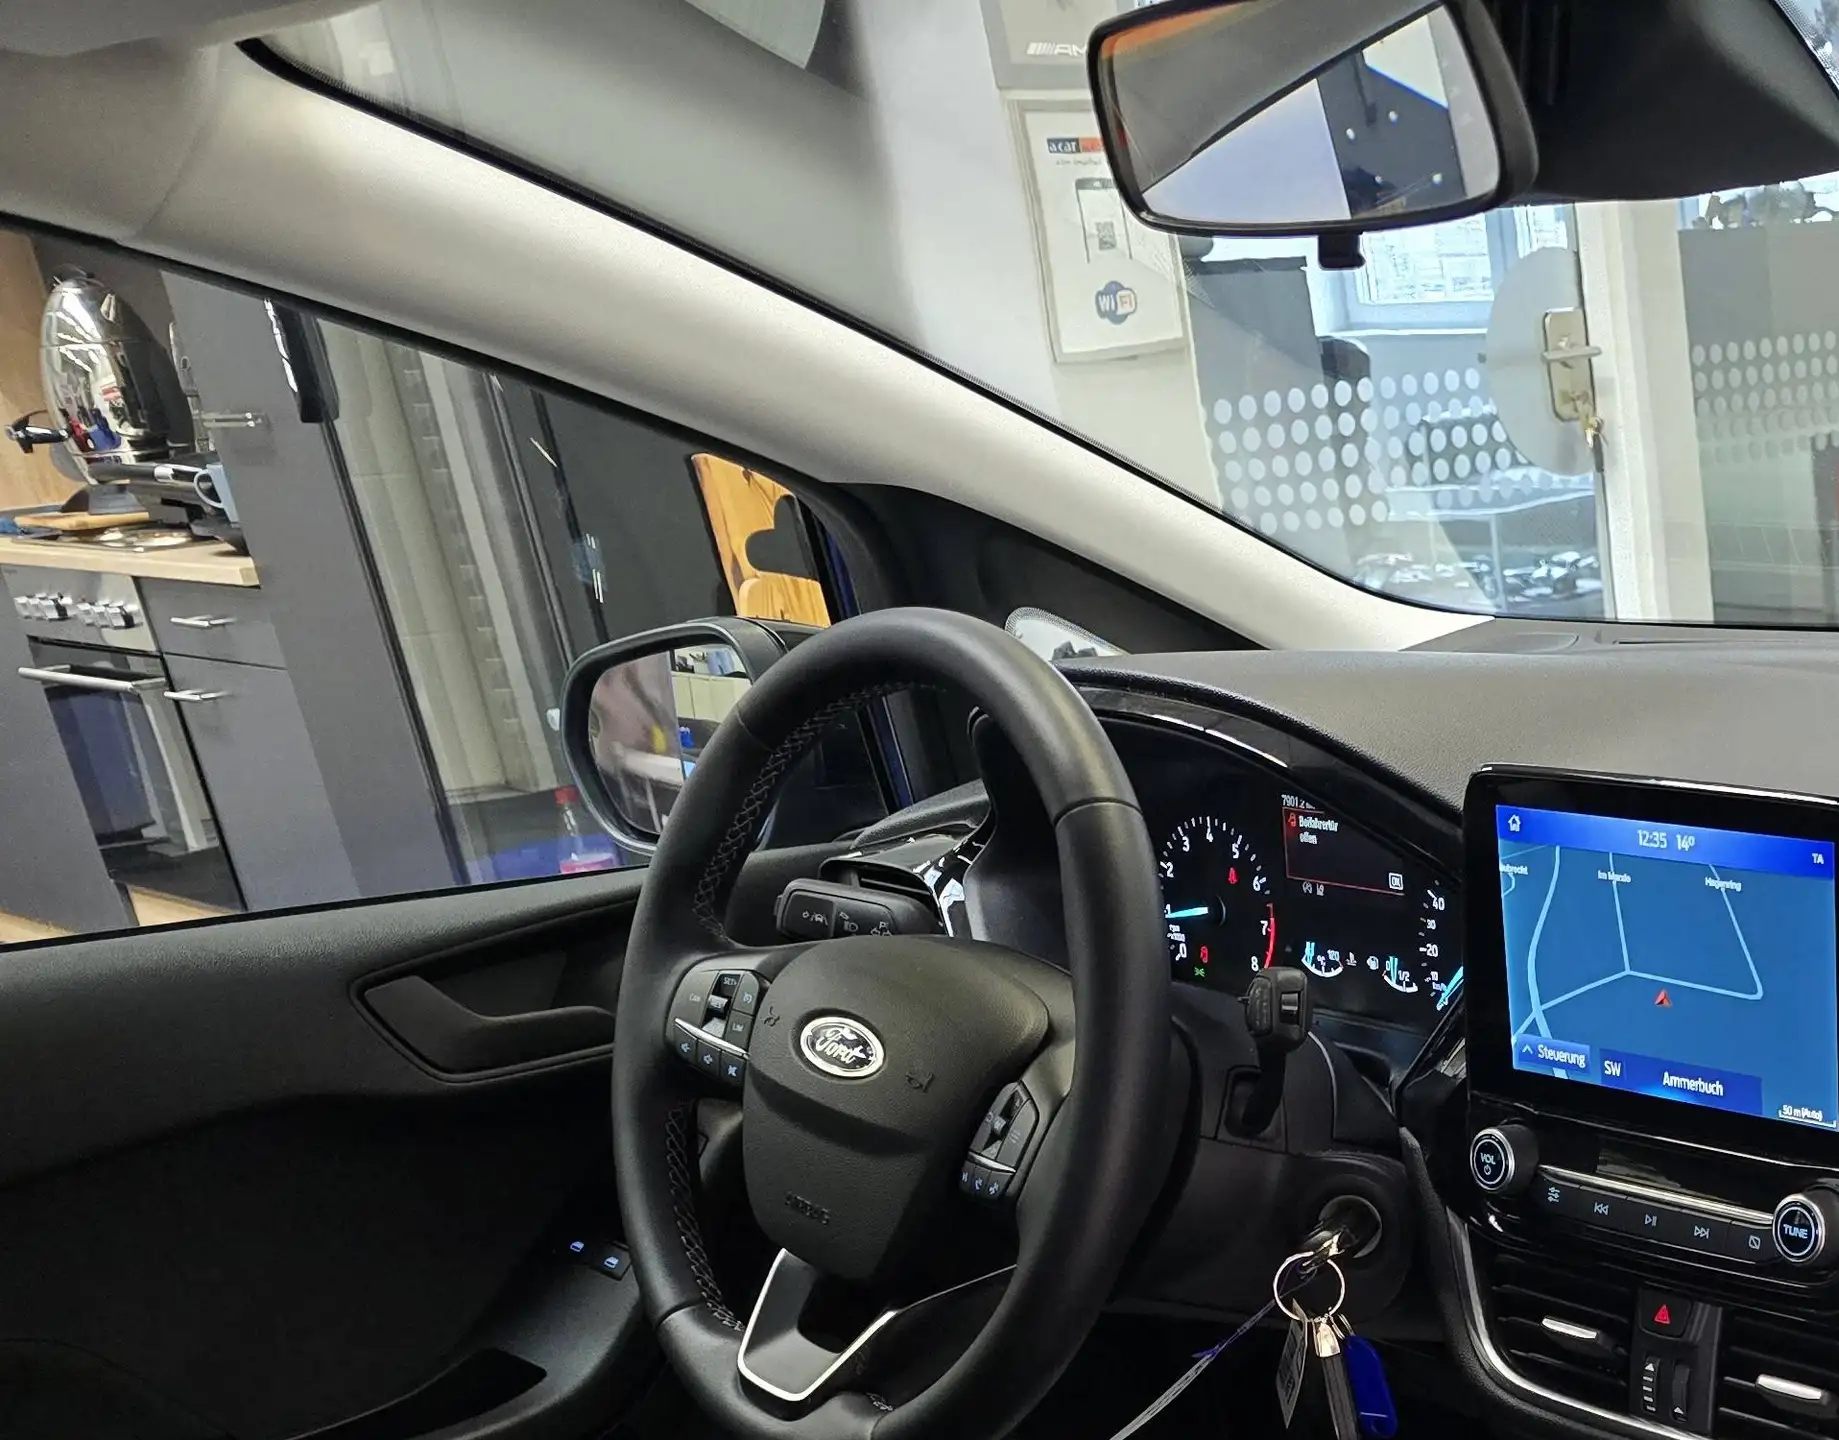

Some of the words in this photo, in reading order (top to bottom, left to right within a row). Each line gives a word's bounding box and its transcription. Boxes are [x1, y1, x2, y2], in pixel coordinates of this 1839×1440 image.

[1182, 836, 1190, 852] 3
[1637, 828, 1668, 849] 12:35
[1231, 843, 1240, 859] 5
[1811, 852, 1824, 865] TA
[1166, 861, 1175, 878] 2
[1252, 875, 1261, 891] 6
[1432, 897, 1446, 911] 40
[1260, 920, 1269, 935] 7
[1426, 918, 1437, 930] 30
[1327, 949, 1340, 961] 120
[1426, 943, 1439, 957] 20
[1250, 955, 1260, 971] 8
[1537, 1043, 1587, 1069] Steuerung
[1604, 1060, 1622, 1077] SW
[1662, 1070, 1725, 1097] Ammerbuch
[1782, 1104, 1793, 1116] 50
[1480, 1152, 1497, 1165] VOL
[1783, 1223, 1808, 1240] TUNE
